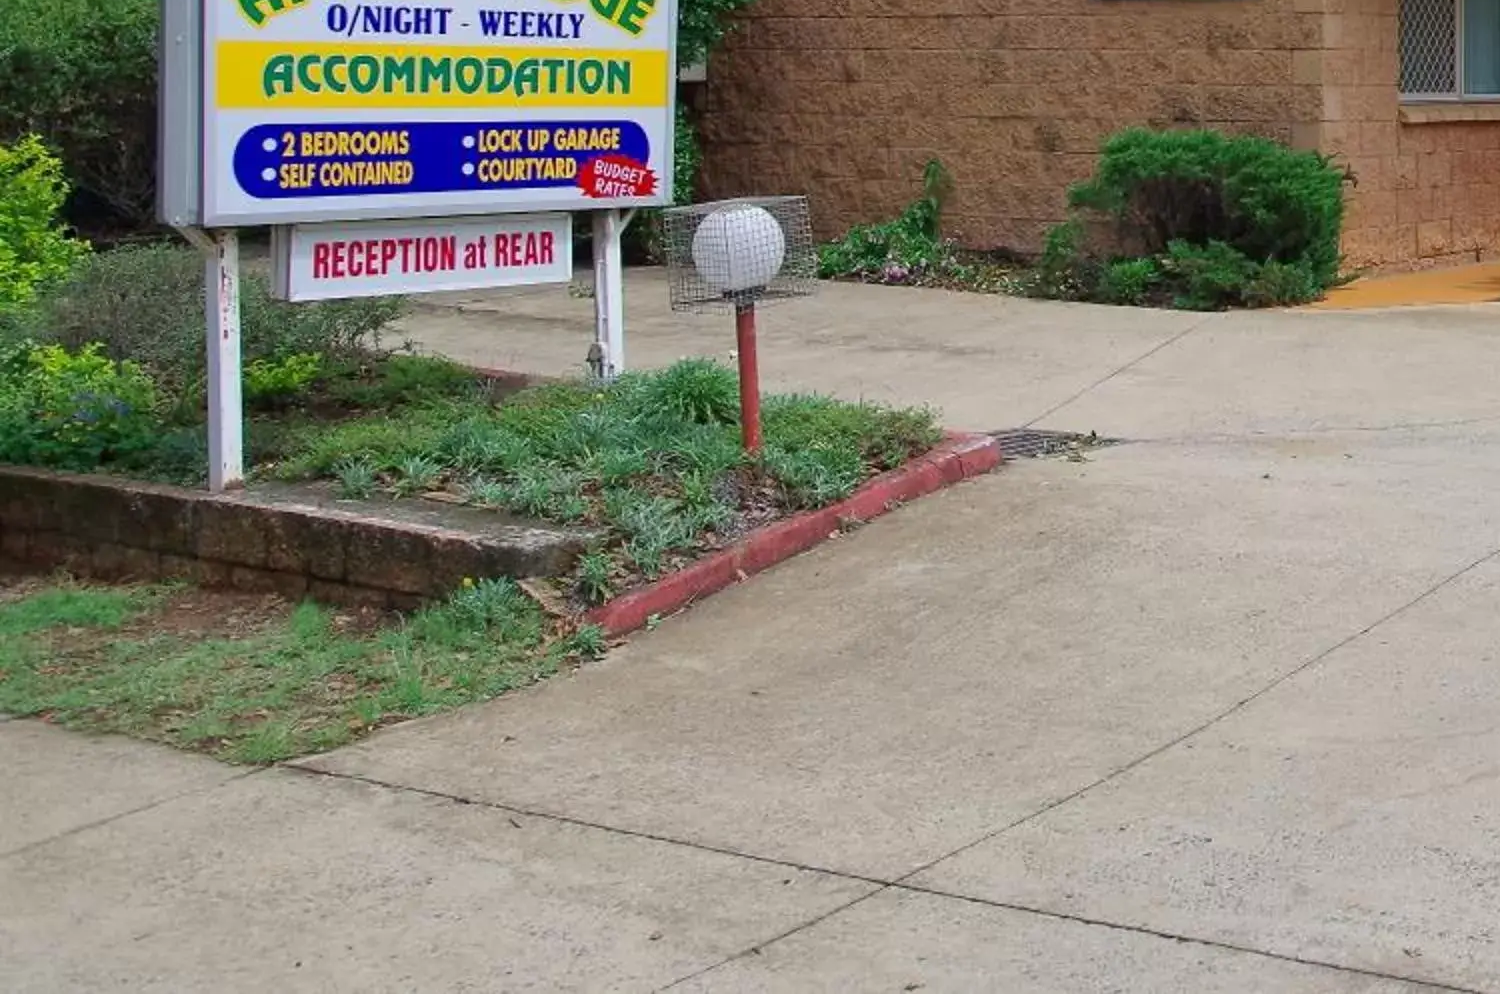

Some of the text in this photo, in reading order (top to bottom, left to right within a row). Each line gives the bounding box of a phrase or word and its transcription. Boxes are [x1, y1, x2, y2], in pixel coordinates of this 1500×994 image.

[327, 3, 452, 37] O/NIGHT
[479, 10, 584, 39] WEEKLY
[262, 55, 631, 98] ACCOMMODATION
[281, 131, 410, 157] 2 BEDROOMS
[478, 128, 620, 153] LOCK UP GARAGE
[279, 161, 413, 188] SELF CONTAINED
[477, 158, 577, 182] COURTYARD
[593, 159, 647, 185] BUDGET
[595, 178, 636, 197] RATES
[313, 231, 554, 279] RECEPTION at REAR
